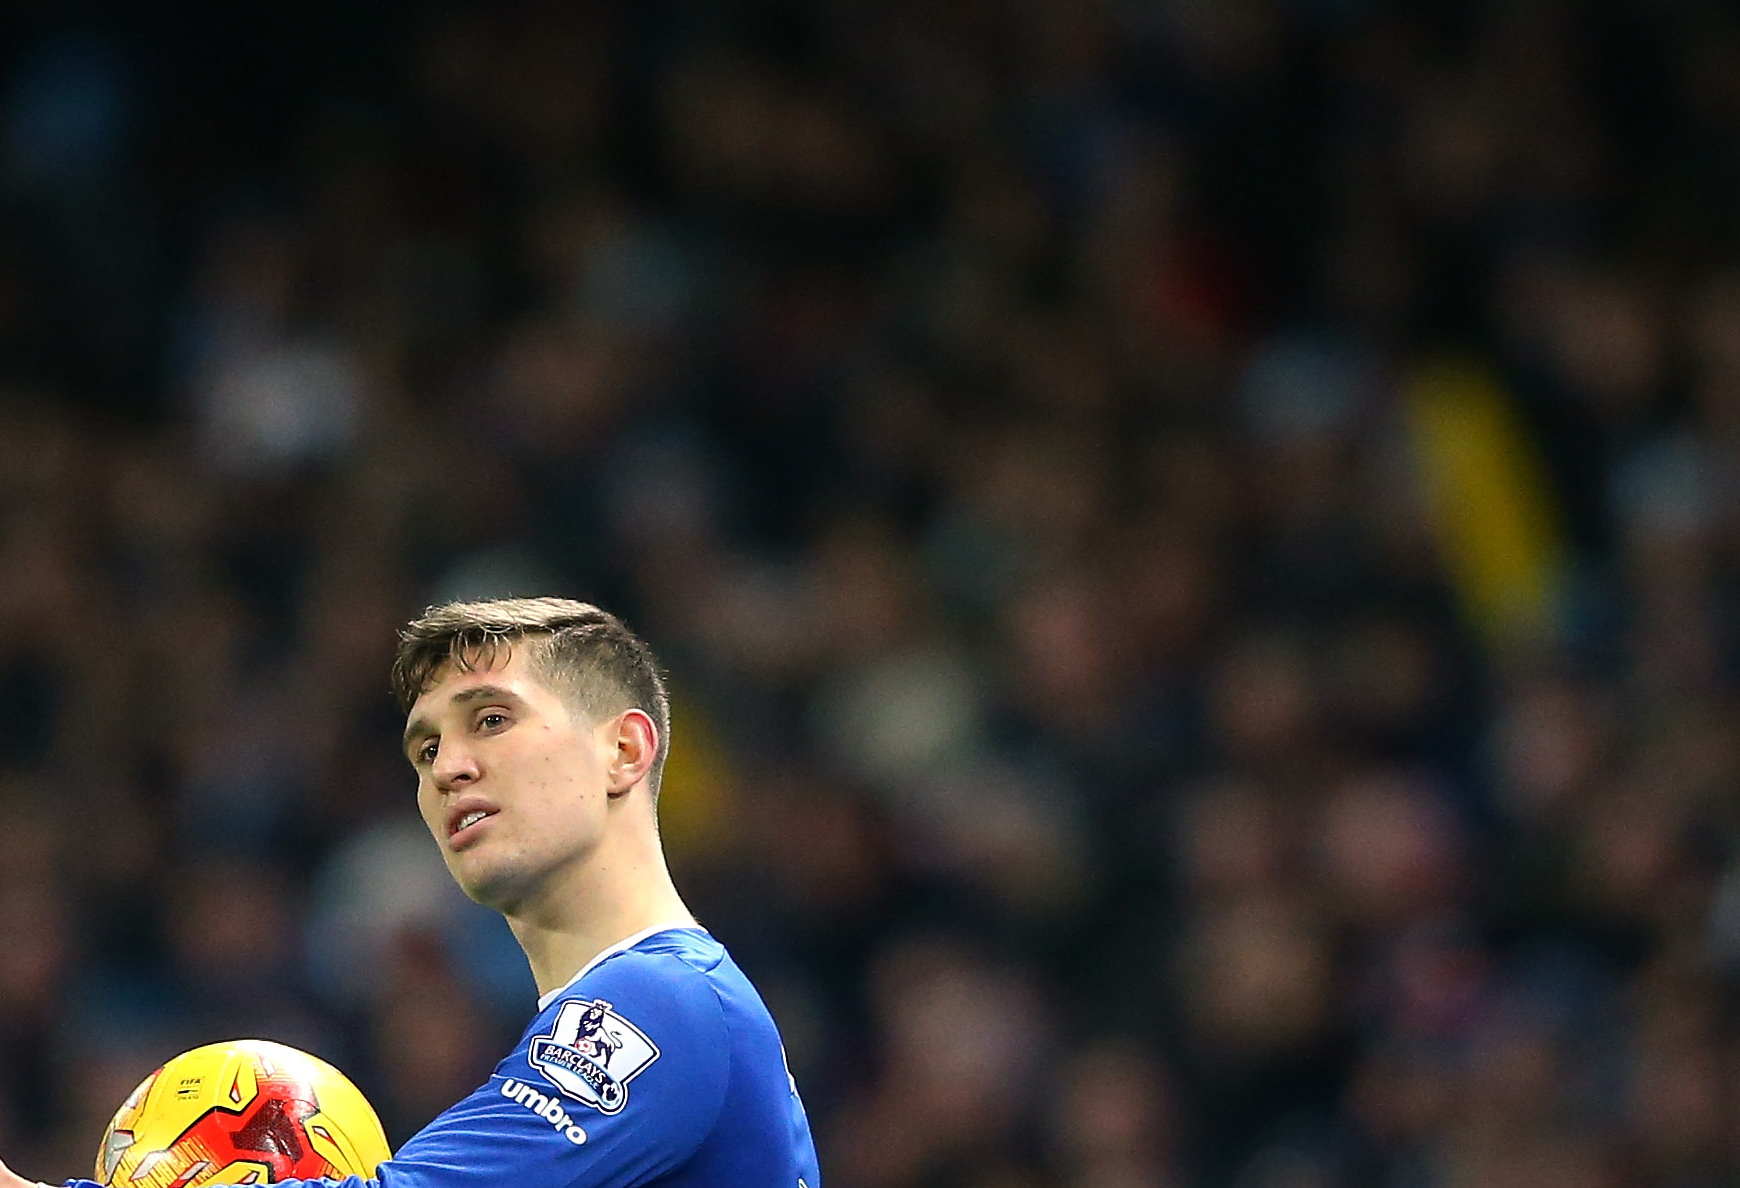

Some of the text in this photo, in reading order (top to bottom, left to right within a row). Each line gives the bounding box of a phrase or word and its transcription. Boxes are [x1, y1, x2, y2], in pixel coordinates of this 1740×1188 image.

[180, 1078, 201, 1086] FIFA
[539, 1053, 600, 1090] PREMIER LEAGUE
[544, 1045, 606, 1083] BARCLAYS
[500, 1079, 588, 1146] umbro
